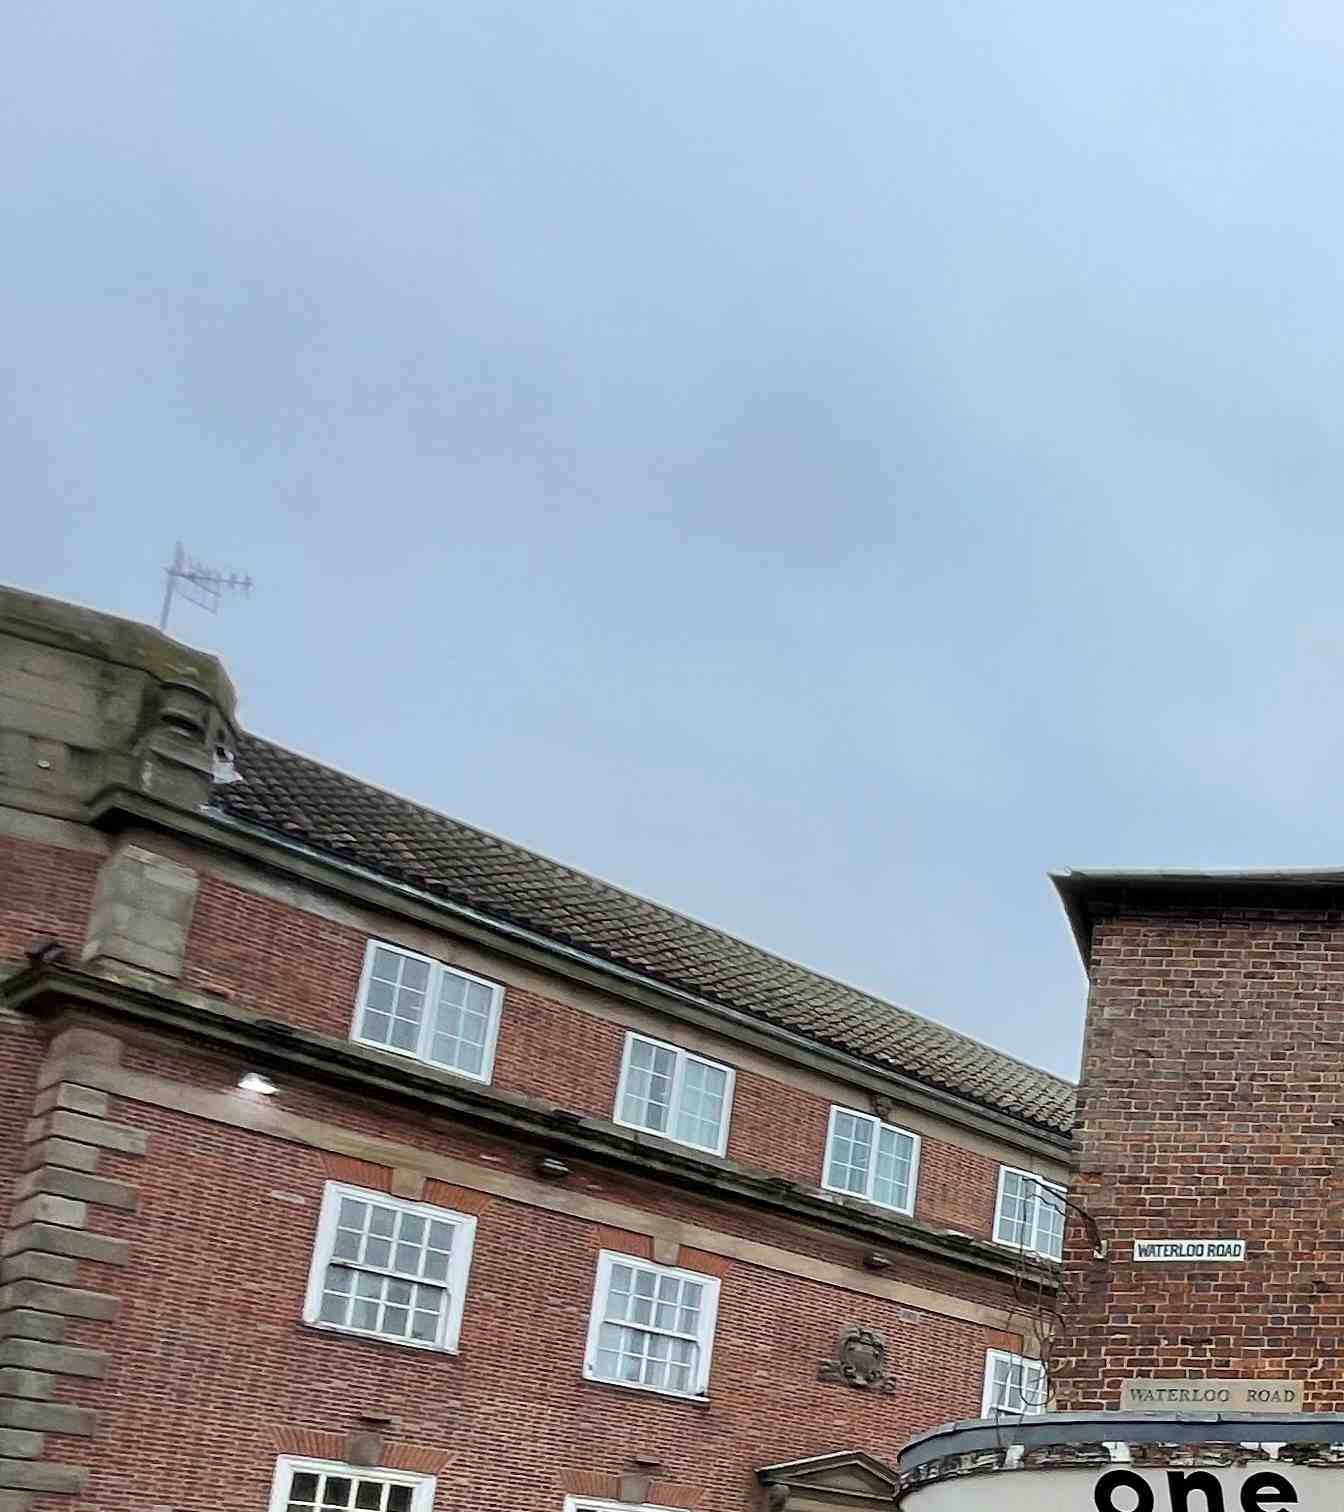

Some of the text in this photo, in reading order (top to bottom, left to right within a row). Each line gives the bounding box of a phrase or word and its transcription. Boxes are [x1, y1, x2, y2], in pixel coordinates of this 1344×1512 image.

[1137, 1243, 1242, 1258] WATERLOO ROAD
[1130, 1388, 1296, 1402] WATERLOO ROAD
